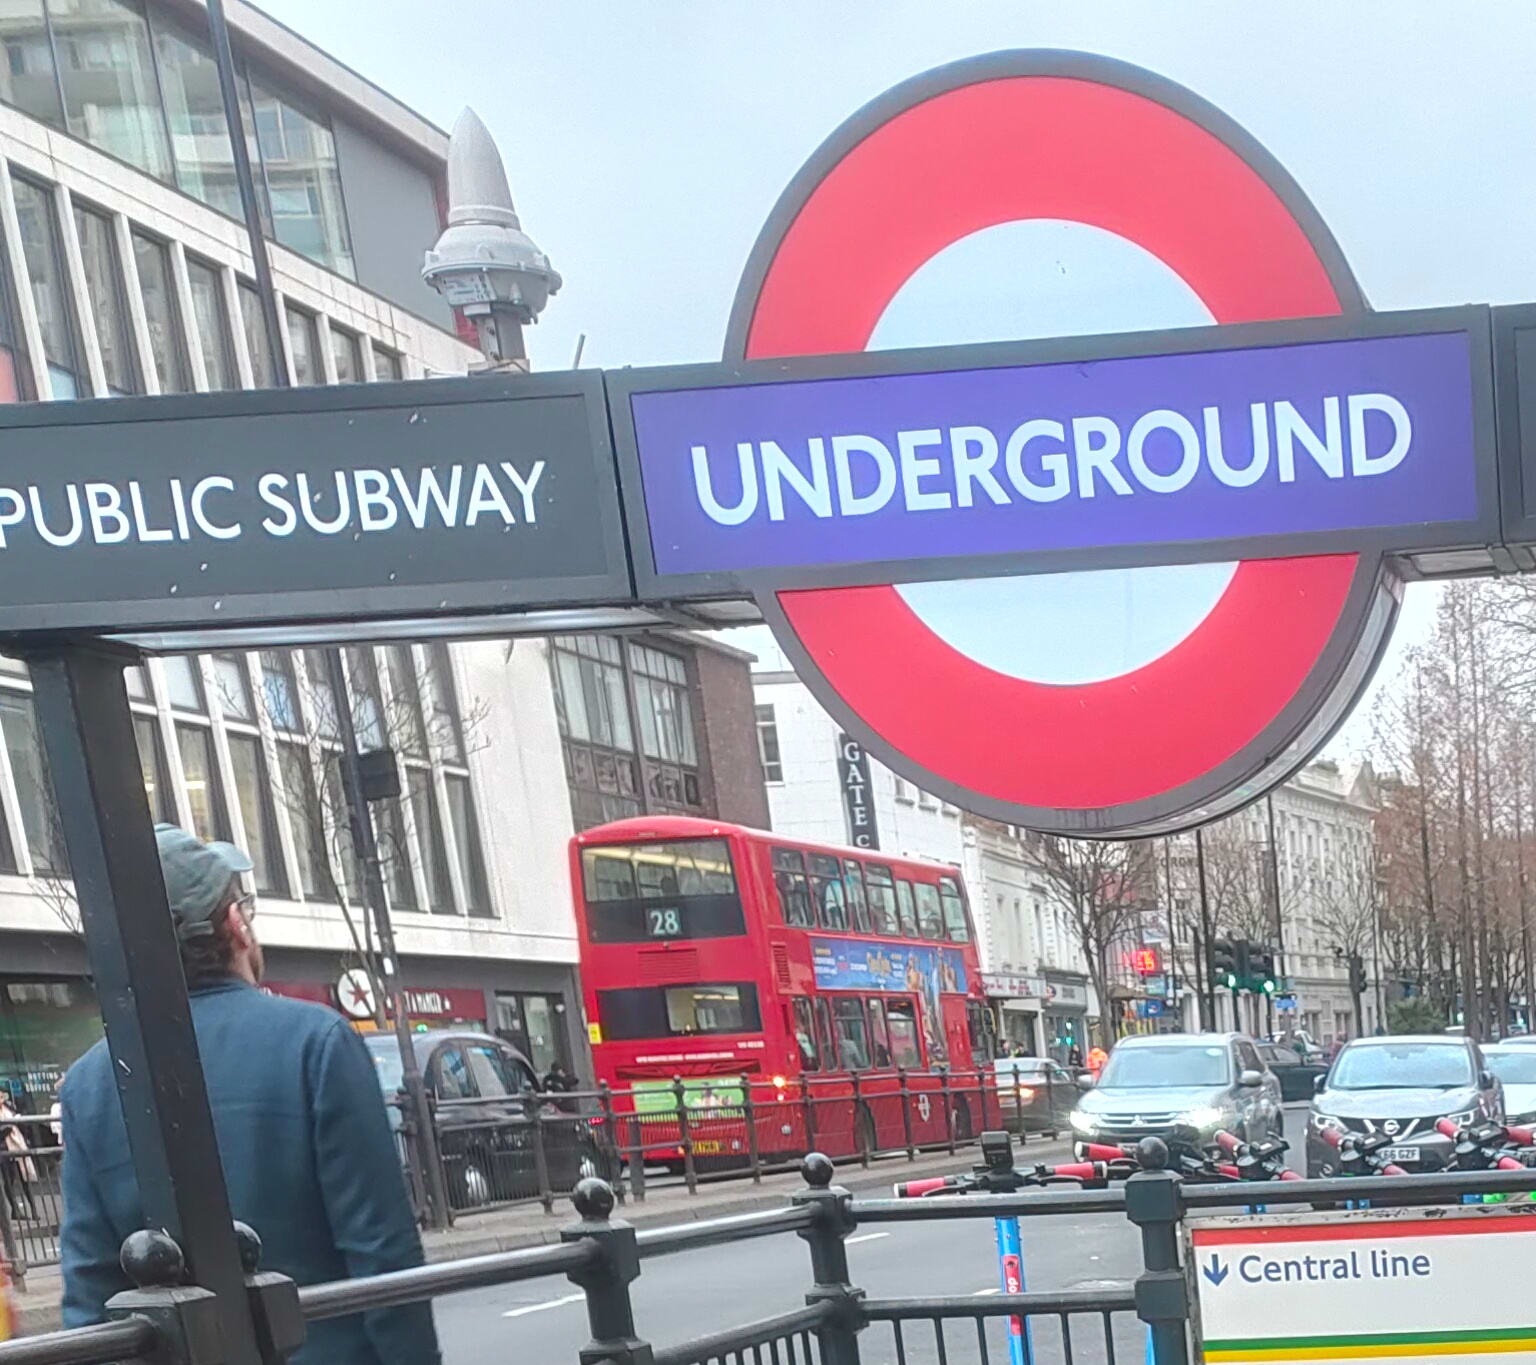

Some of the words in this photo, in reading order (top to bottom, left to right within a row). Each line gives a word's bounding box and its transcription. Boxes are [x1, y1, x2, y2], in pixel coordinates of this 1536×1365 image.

[691, 393, 1413, 527] UNDERGROUND
[0, 476, 242, 548] PUBLIC
[258, 460, 546, 537] SUBWAY
[844, 742, 867, 826] GATE
[650, 910, 679, 935] 28
[1239, 1253, 1363, 1284] Central
[1371, 1249, 1431, 1280] line
